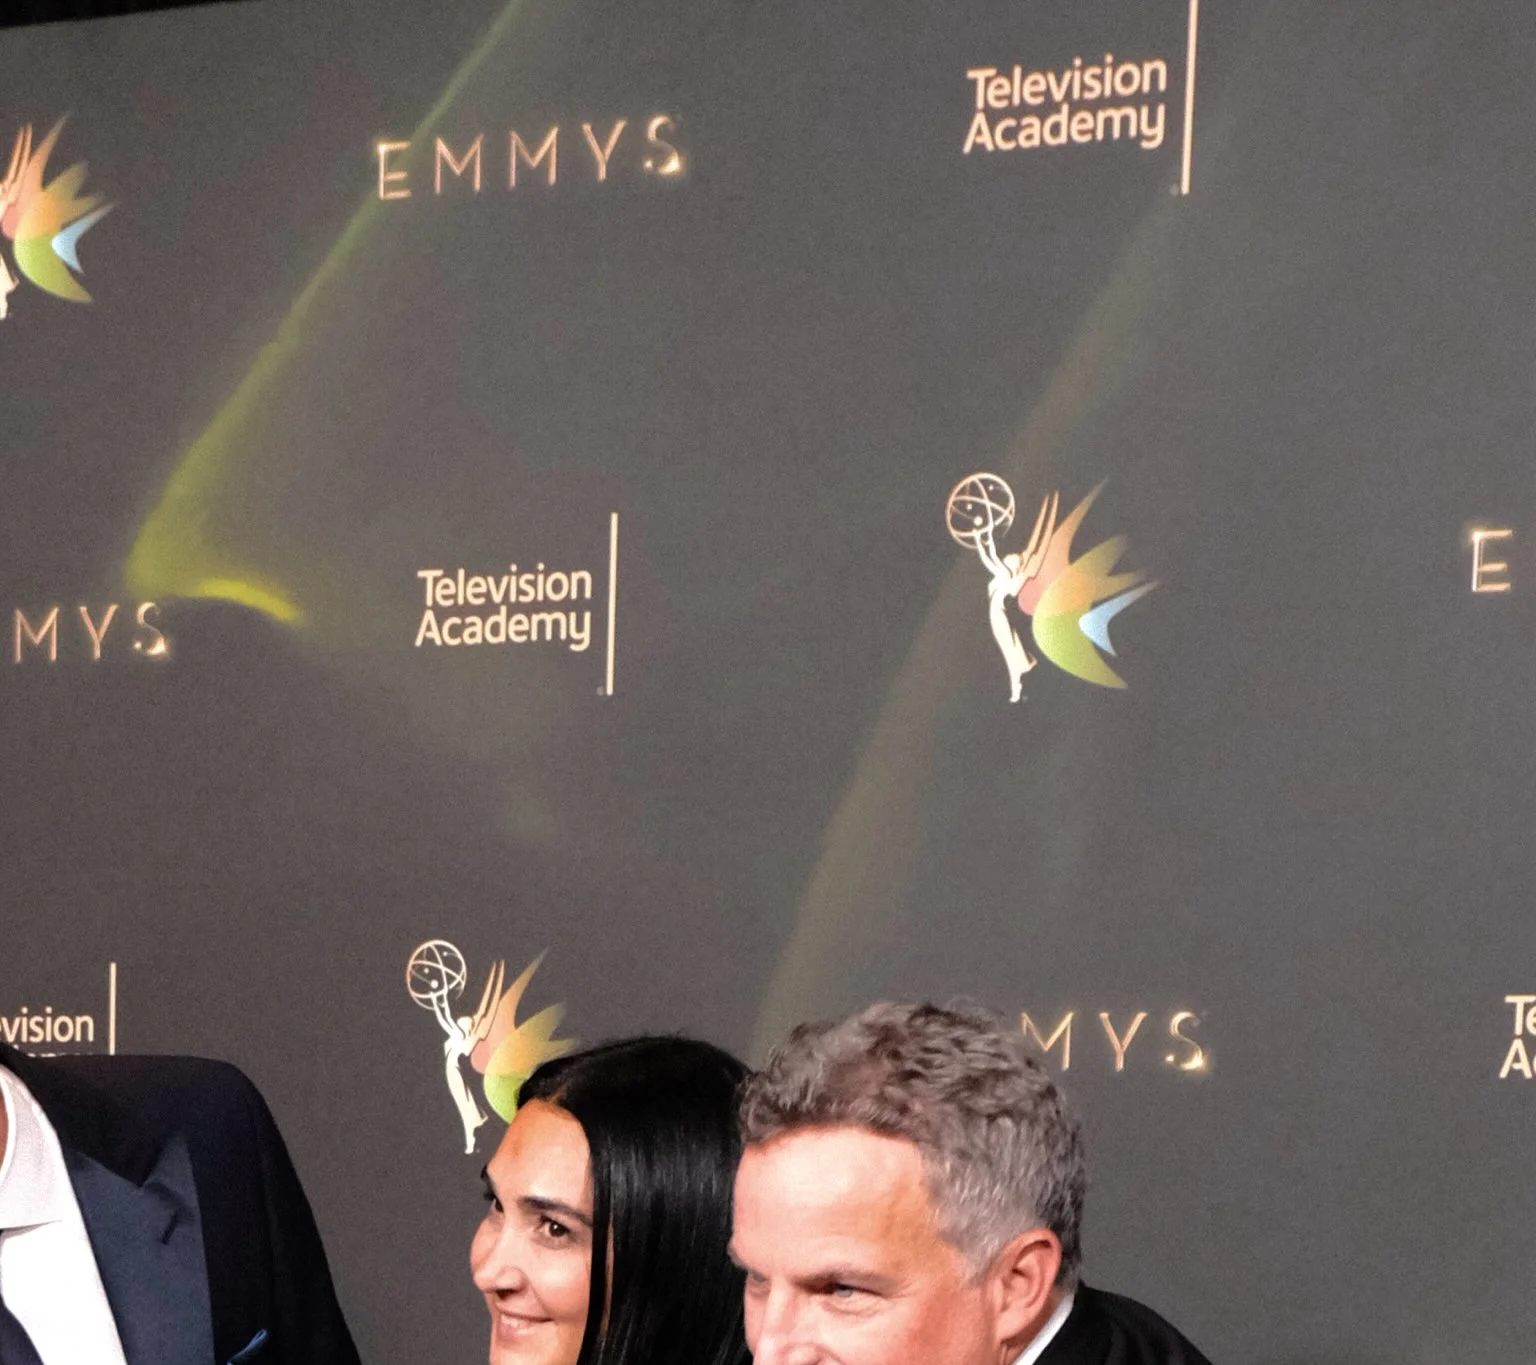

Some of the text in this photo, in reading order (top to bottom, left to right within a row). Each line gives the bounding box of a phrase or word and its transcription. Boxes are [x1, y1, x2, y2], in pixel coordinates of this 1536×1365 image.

[966, 52, 1168, 110] Television
[962, 101, 1166, 155] Academy
[375, 115, 687, 201] EMMYS
[416, 561, 593, 608] Television
[414, 604, 592, 653] Academy
[1020, 1010, 1212, 1073] MYS
